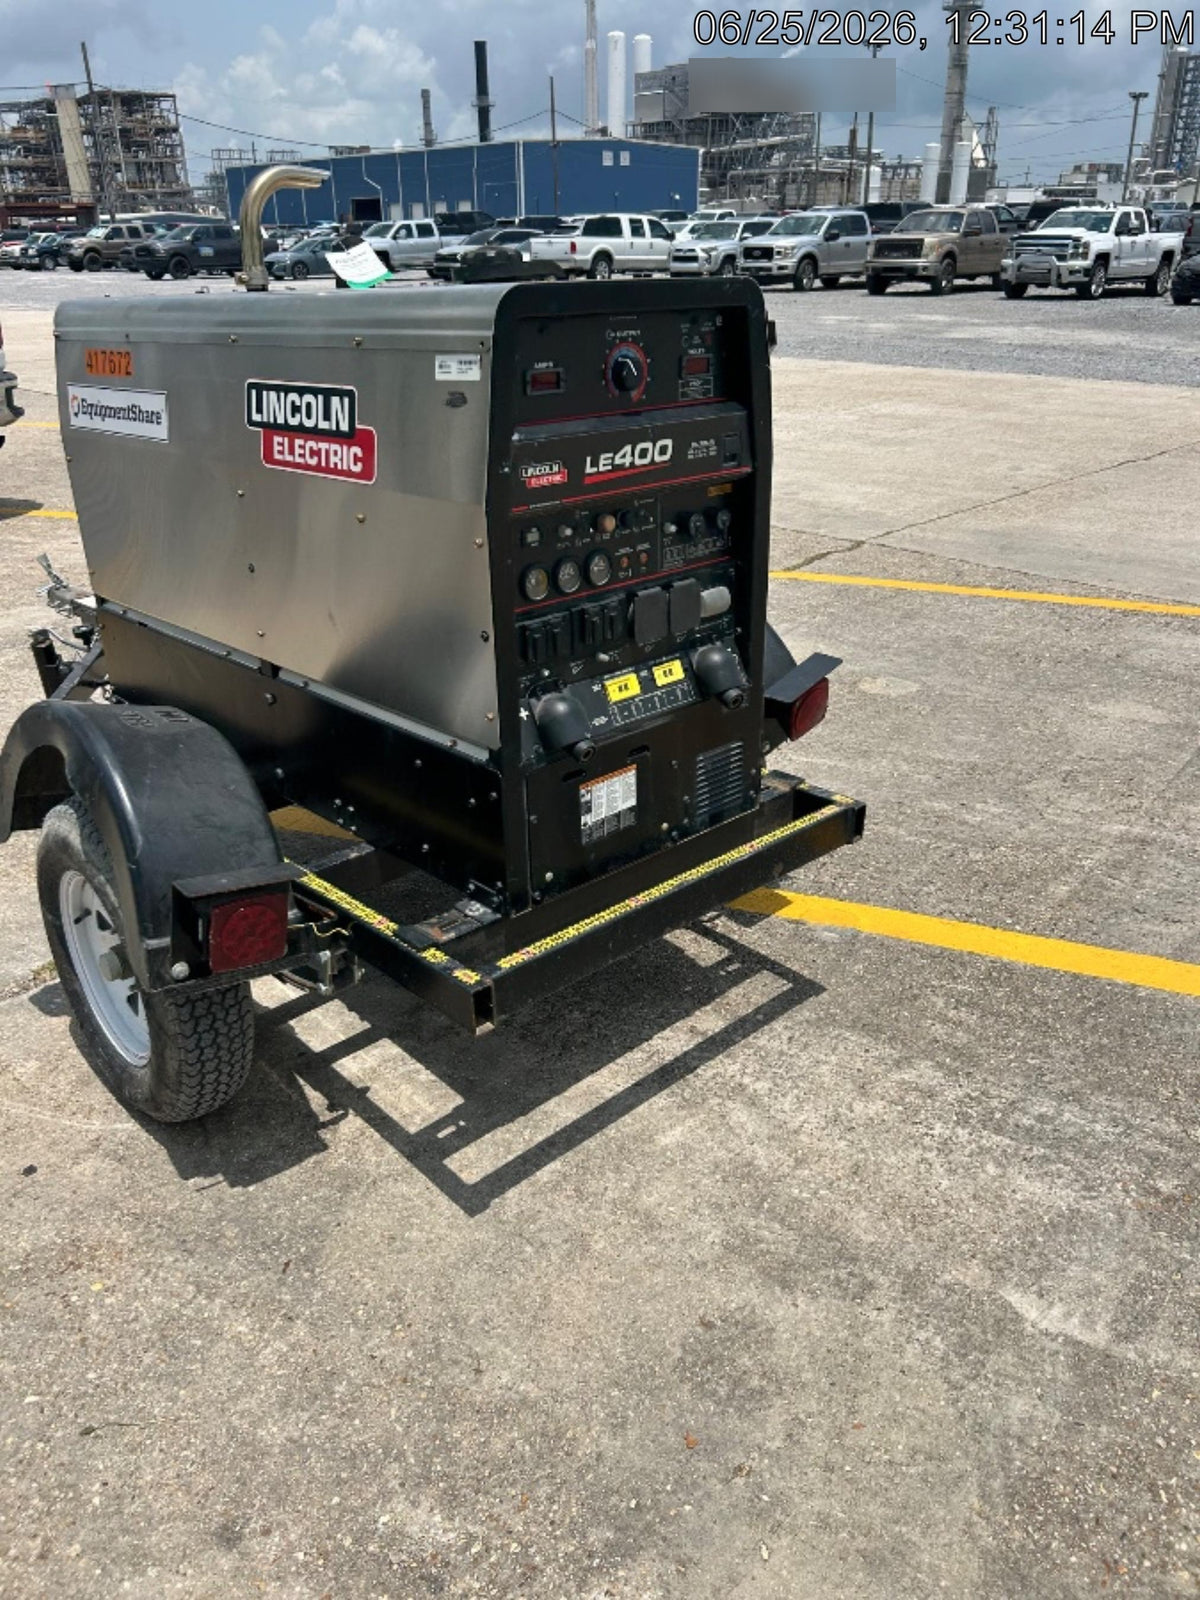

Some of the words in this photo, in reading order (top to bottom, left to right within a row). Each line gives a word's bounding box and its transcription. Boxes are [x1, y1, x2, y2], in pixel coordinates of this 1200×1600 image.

[86, 350, 132, 376] 417672
[80, 398, 162, 425] EquipmentShare
[251, 388, 349, 432] LINCOLN
[273, 435, 363, 473] ELECTRIC
[584, 438, 673, 474] LE400
